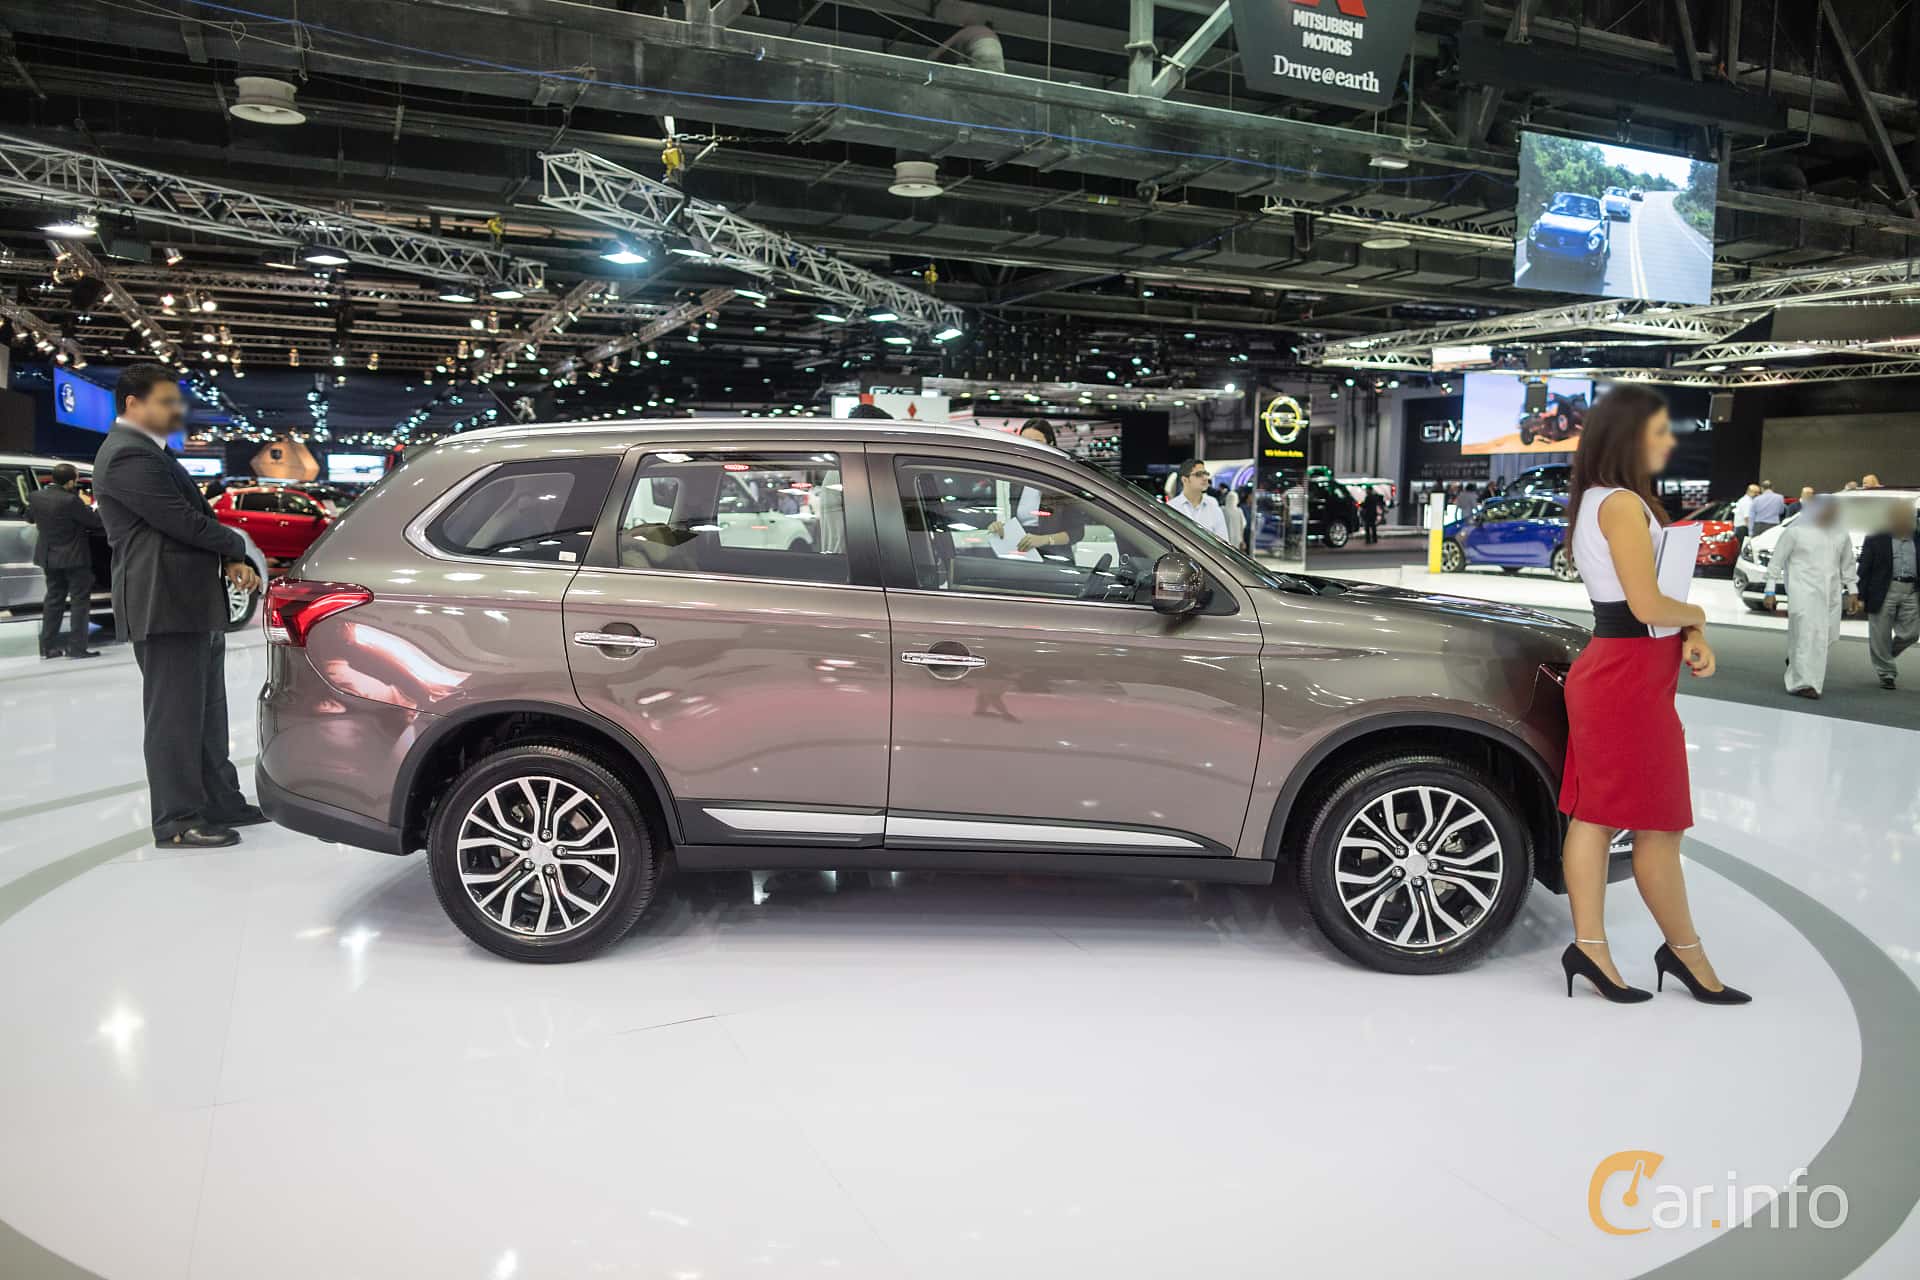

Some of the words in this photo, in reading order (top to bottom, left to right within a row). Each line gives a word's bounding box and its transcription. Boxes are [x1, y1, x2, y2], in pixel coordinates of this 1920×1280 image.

[1292, 9, 1363, 39] MITSUBISHI
[1302, 31, 1353, 56] MOTORS
[1272, 54, 1380, 93] Drive@earth
